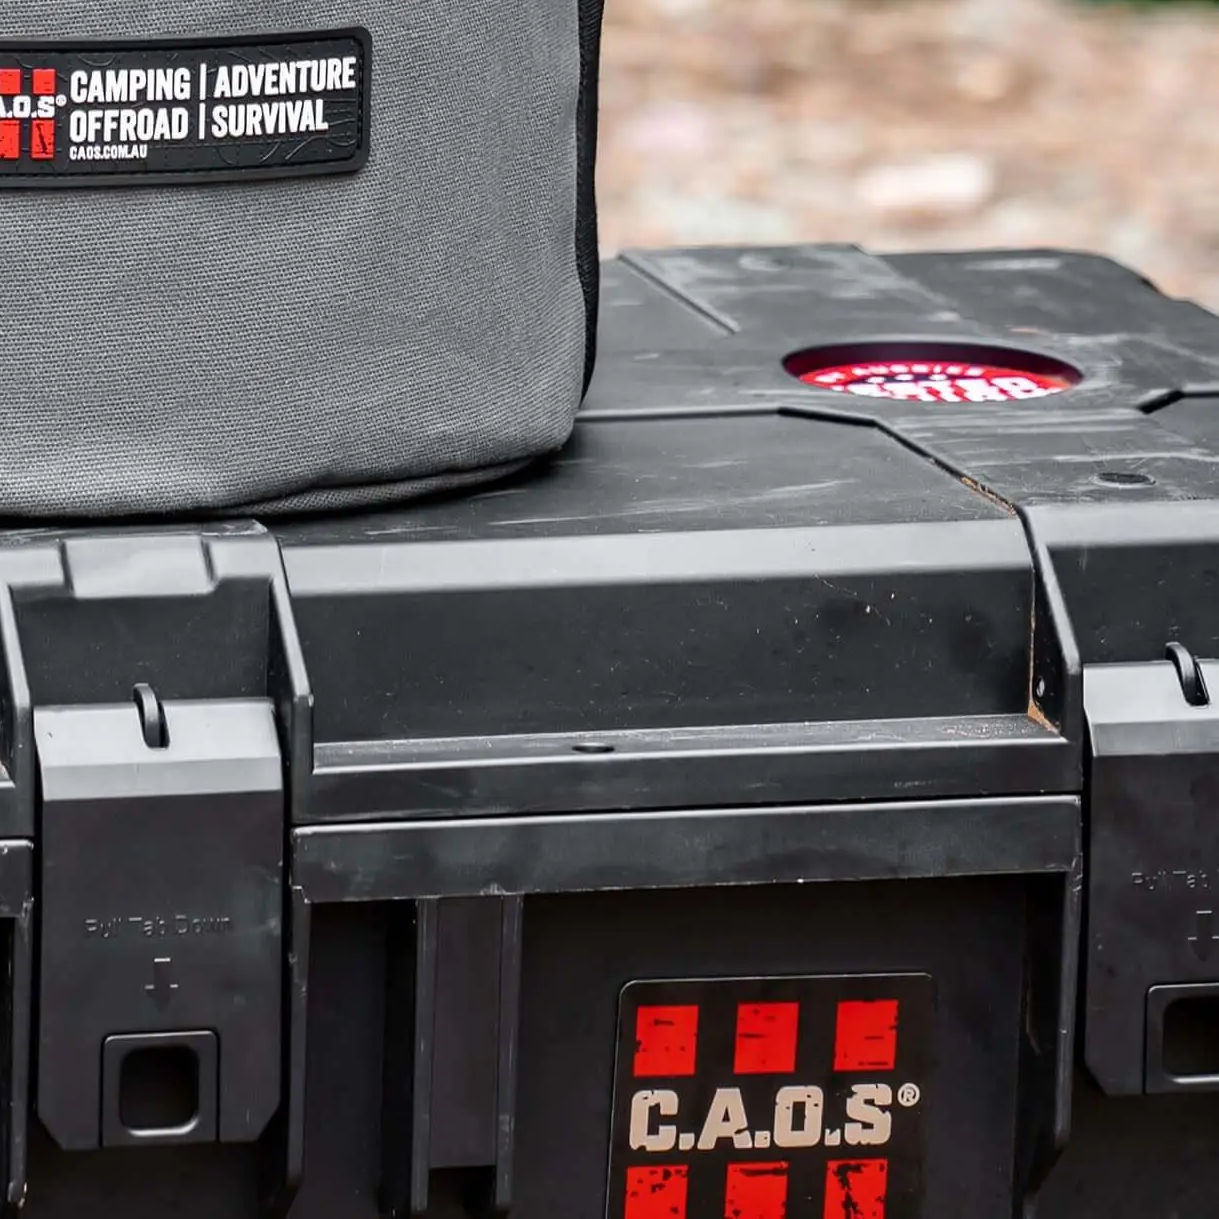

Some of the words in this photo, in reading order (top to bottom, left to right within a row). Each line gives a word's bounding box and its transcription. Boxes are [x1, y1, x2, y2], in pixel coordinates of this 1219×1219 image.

[70, 67, 191, 103] CAMPING
[213, 56, 357, 99] ADVENTURE
[69, 107, 189, 143] OFFROAD
[211, 98, 329, 139] SURVIVAL
[69, 144, 148, 160] CAOS.COM.AU
